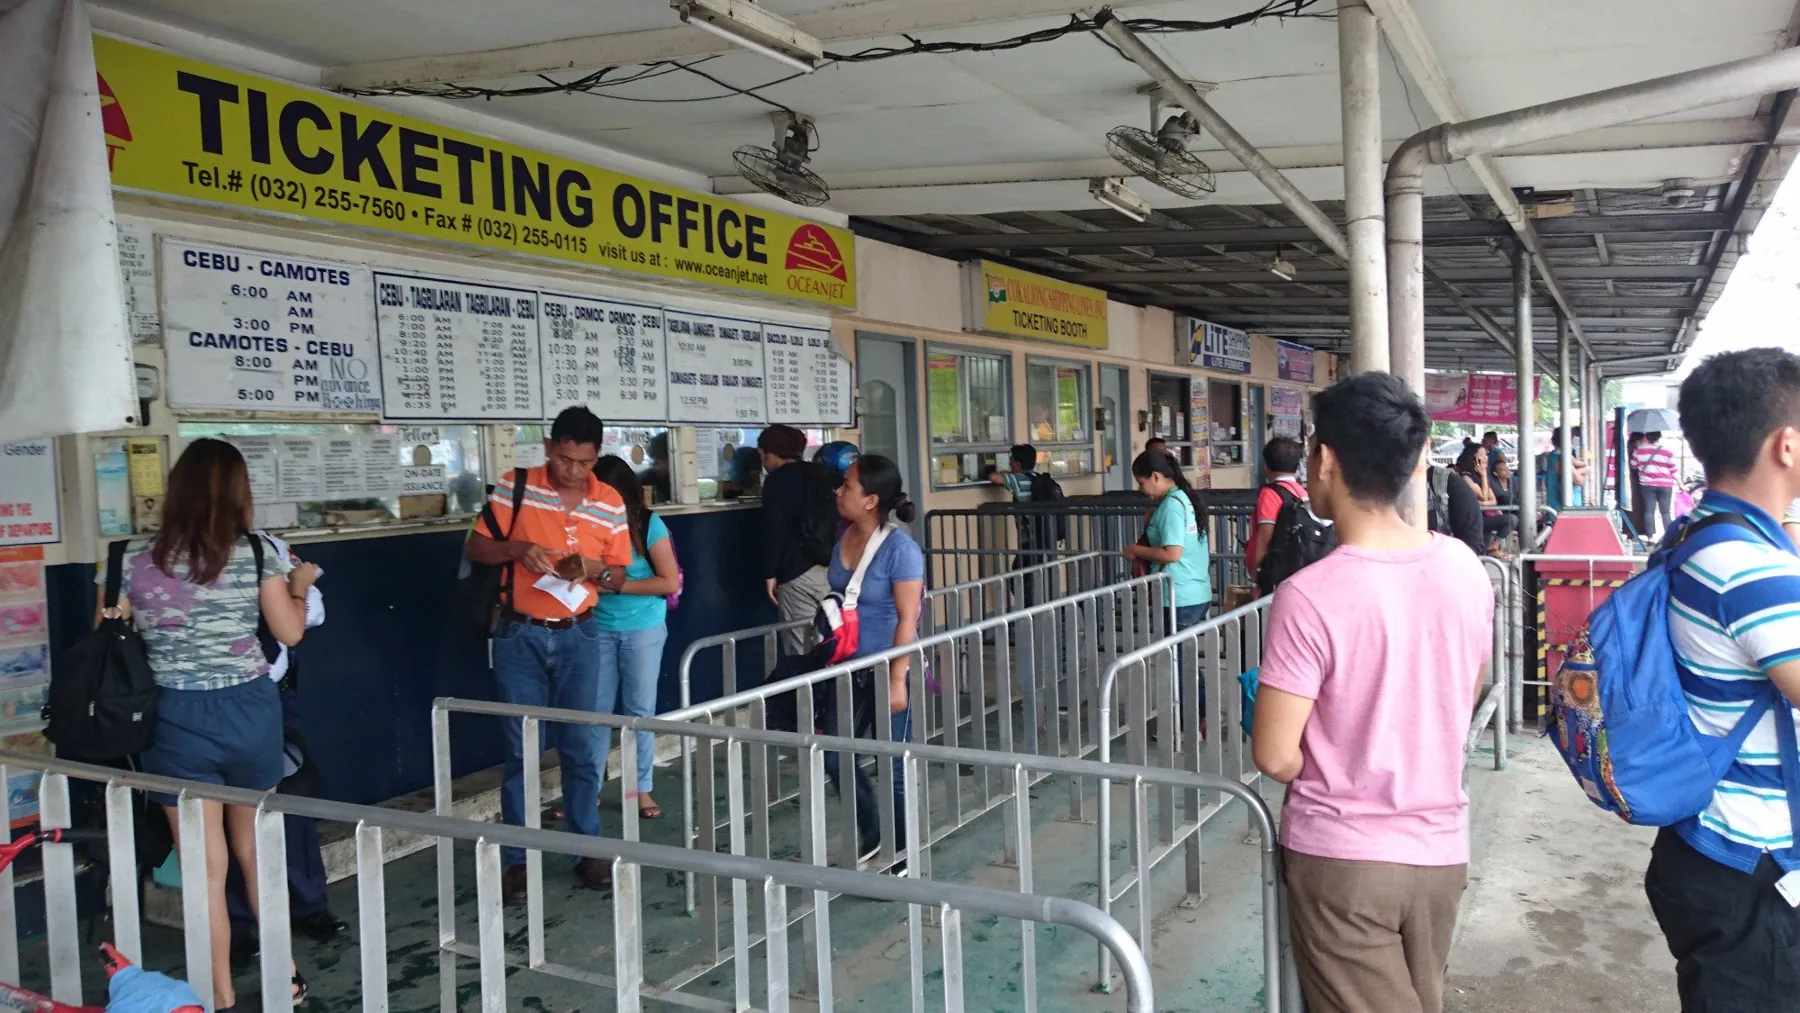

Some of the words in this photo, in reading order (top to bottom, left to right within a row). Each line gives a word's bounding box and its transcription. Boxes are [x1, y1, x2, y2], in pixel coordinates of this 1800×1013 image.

[177, 71, 593, 228] TICKETING
[612, 183, 768, 264] OFFICE
[182, 161, 242, 192] Tel.#
[251, 174, 307, 208] (032)
[315, 186, 405, 221] 255-7560
[424, 207, 456, 230] Fax
[462, 214, 472, 232] #
[478, 217, 517, 245] (032)
[523, 226, 587, 253] 255-0115
[183, 250, 239, 272] CEBU
[260, 261, 350, 286] CAMOTES
[599, 244, 627, 261] visit
[630, 252, 645, 264] us
[649, 252, 661, 266] at
[675, 257, 768, 286] www.oceanjet.net
[787, 274, 846, 300] OCEANJET
[231, 284, 268, 298] 6:00
[286, 291, 312, 303] AM
[380, 283, 403, 307] CEBU
[410, 286, 462, 312] TAGBILARAN
[465, 293, 511, 317] TAGBILARAN
[516, 299, 535, 319] CEBU
[287, 307, 313, 318] AM
[544, 303, 567, 318] CEBU
[575, 306, 604, 322] ORMOC
[233, 318, 270, 331] 3:00
[290, 323, 314, 334] PM
[399, 322, 425, 330] 7:00
[434, 316, 451, 324] AM
[609, 311, 636, 325] ORMOC
[642, 315, 660, 329] CEBU
[1012, 310, 1058, 334] TICKETING
[1060, 320, 1087, 339] BOOTH
[399, 331, 426, 339] 8:00
[584, 332, 598, 342] AM
[189, 332, 288, 352] CAMOTES
[307, 341, 354, 357] CEBU
[400, 340, 427, 348] 9:20
[549, 343, 576, 355] 10:30
[585, 347, 599, 356] AM
[641, 339, 654, 348] AM
[395, 357, 428, 365] 11:40
[642, 352, 654, 360] AM
[235, 356, 272, 368] 8:00
[293, 360, 318, 370] AM
[330, 358, 368, 380] NO
[555, 359, 577, 370] 1:30
[584, 361, 599, 371] PM
[643, 365, 655, 374] PM
[294, 375, 318, 386] PM
[586, 375, 599, 385] PM
[643, 378, 655, 387] PM
[238, 389, 274, 401] 5:00
[295, 392, 320, 402] PM
[587, 390, 600, 400] PM
[644, 391, 657, 400] PM
[404, 468, 441, 478] ON-DATE
[403, 481, 444, 491] ISSUANCE
[8, 522, 53, 537] DEPARTURE
